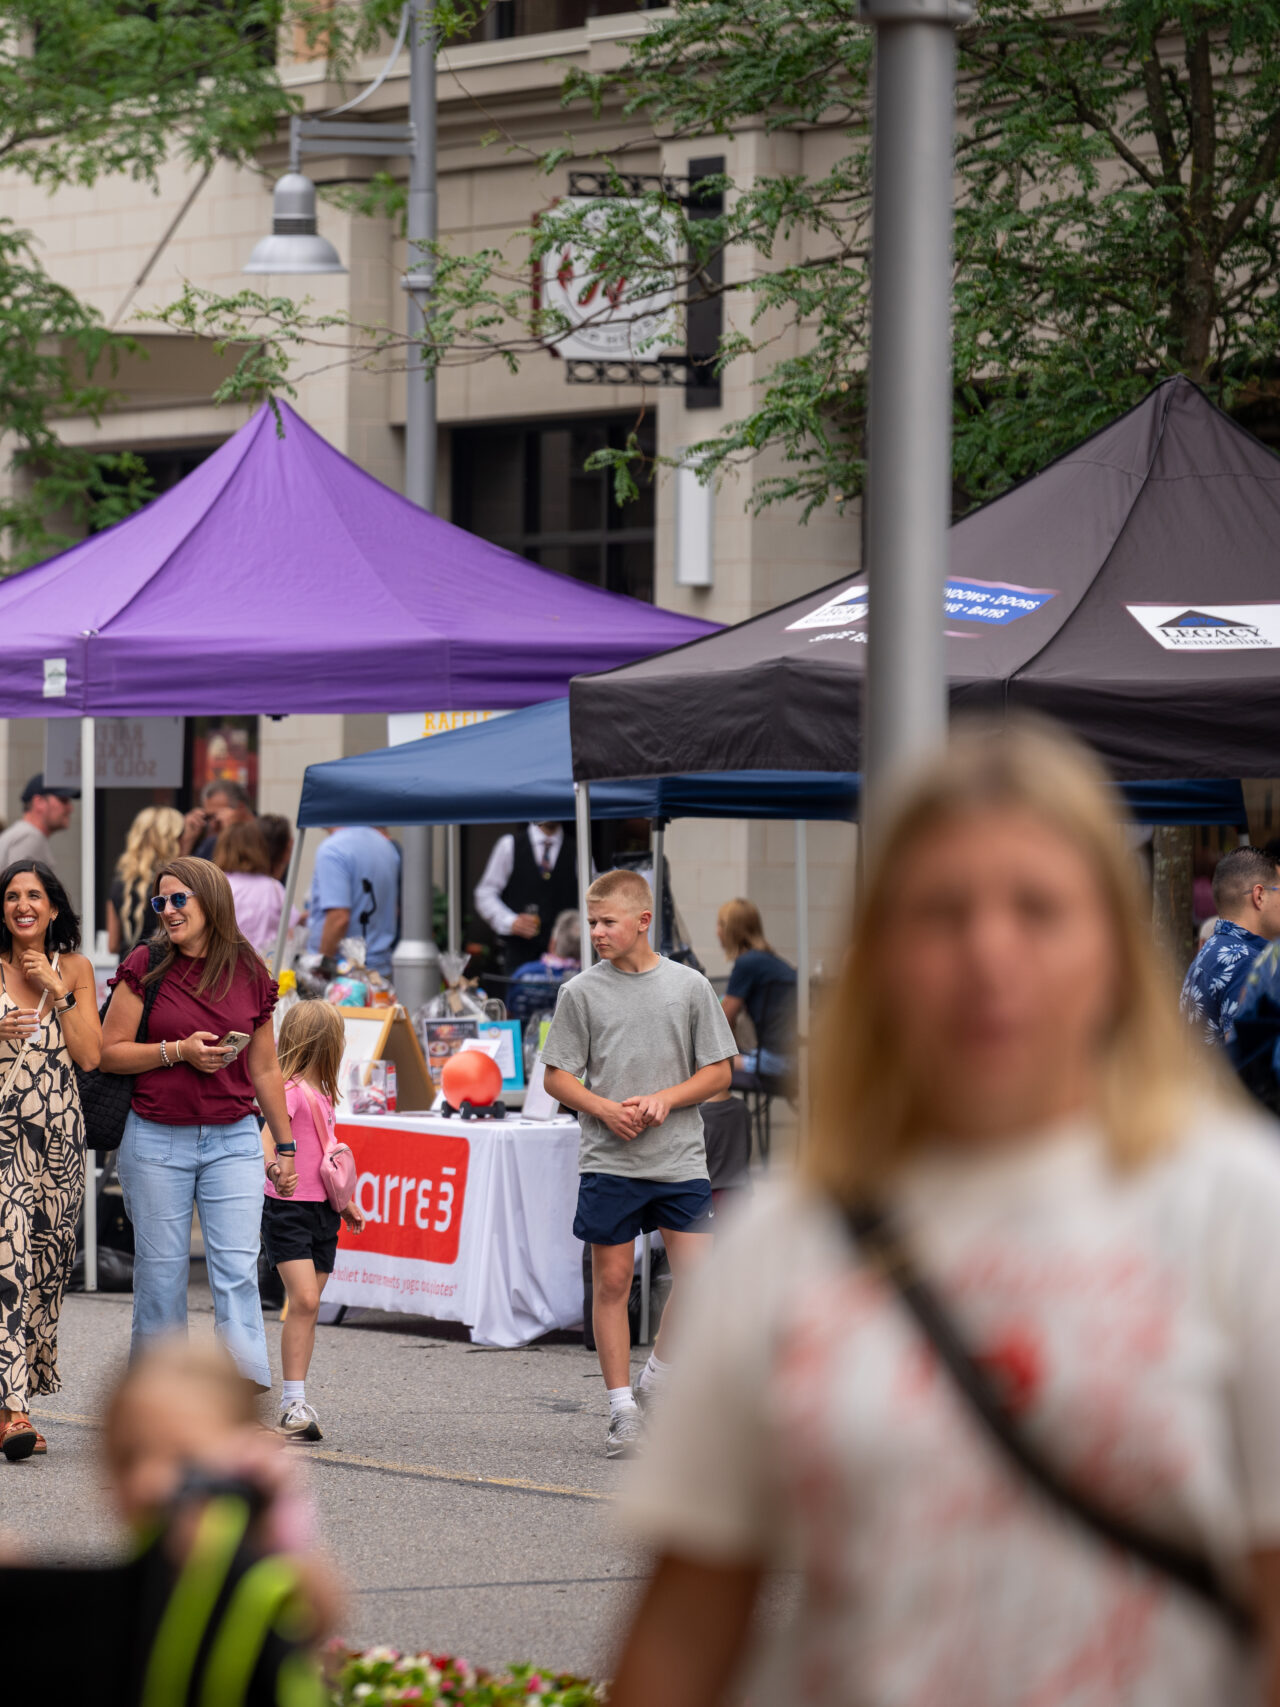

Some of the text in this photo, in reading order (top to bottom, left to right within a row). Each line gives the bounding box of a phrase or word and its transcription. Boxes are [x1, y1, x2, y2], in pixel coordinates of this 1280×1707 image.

[994, 595, 1040, 610] DOORS
[966, 606, 1009, 618] BATHS
[1160, 628, 1262, 638] LEGACY
[1169, 637, 1273, 647] Remodeling
